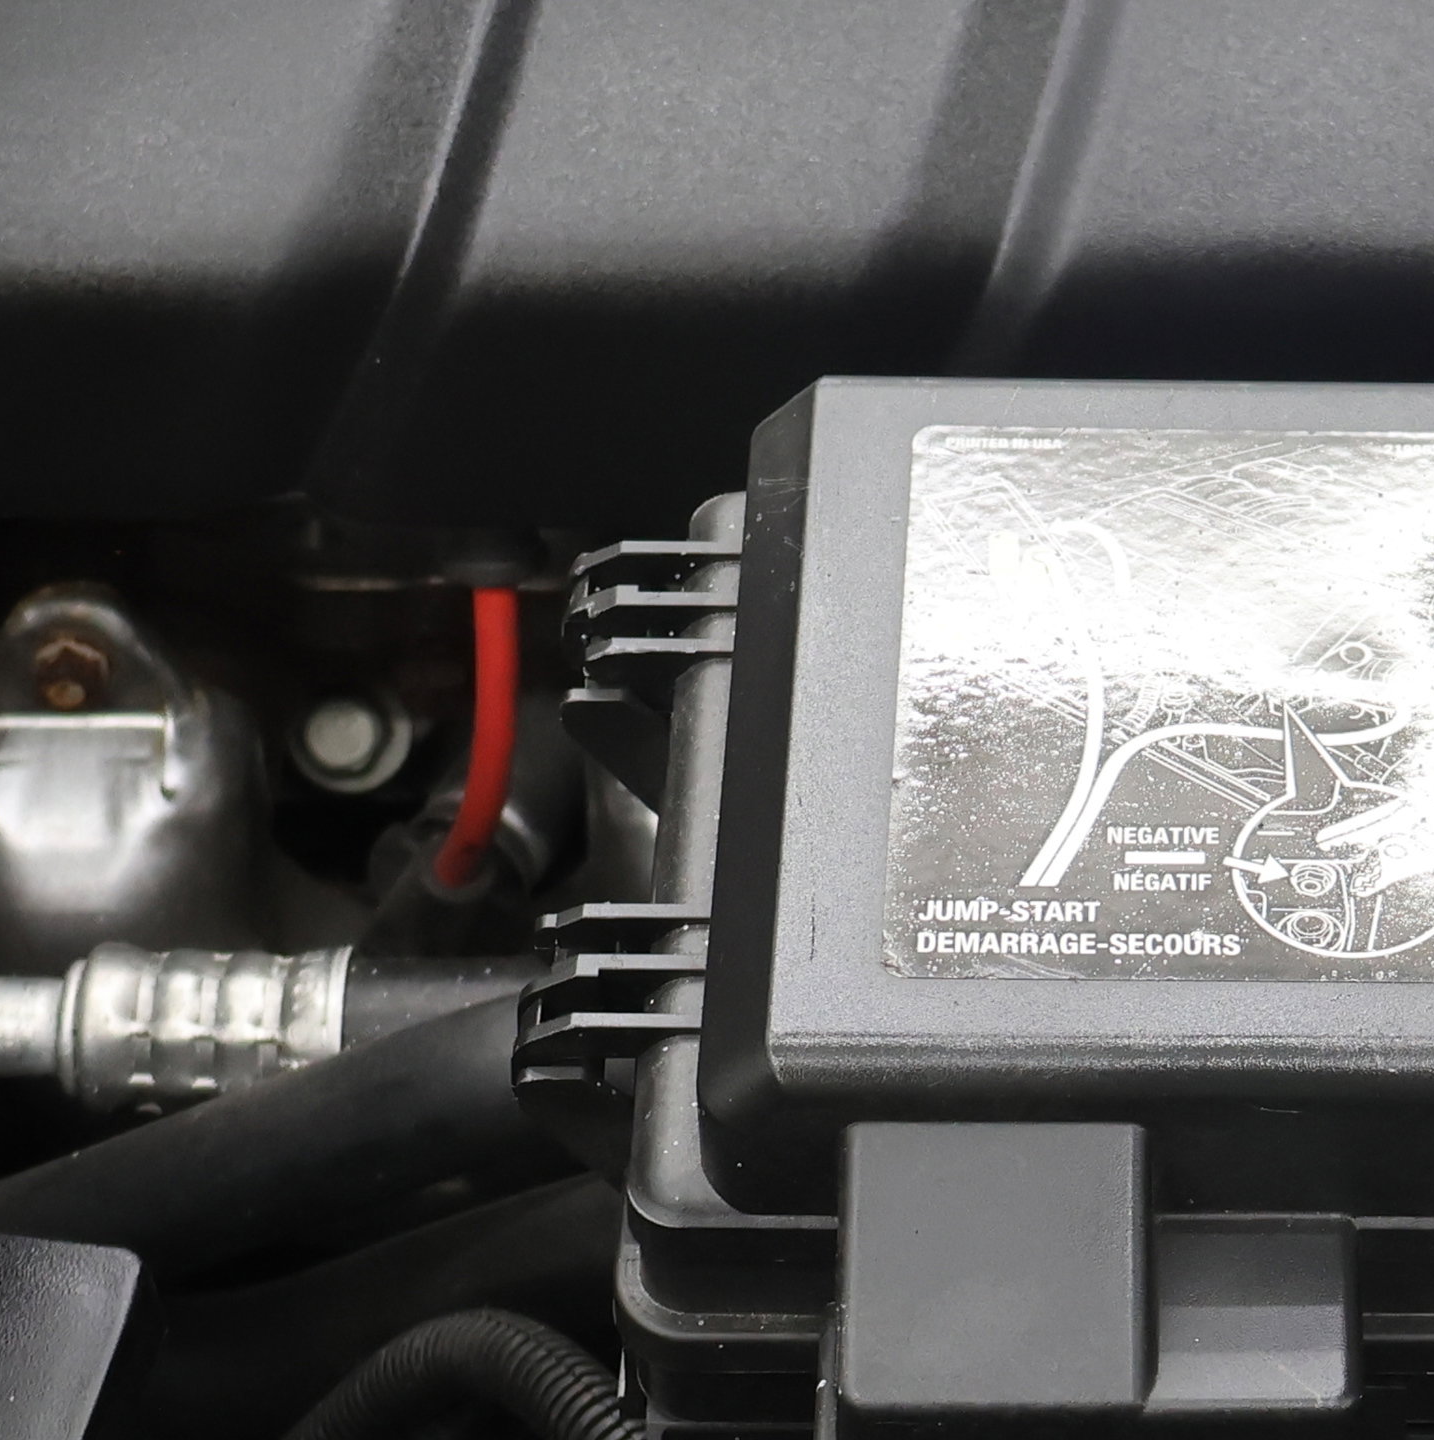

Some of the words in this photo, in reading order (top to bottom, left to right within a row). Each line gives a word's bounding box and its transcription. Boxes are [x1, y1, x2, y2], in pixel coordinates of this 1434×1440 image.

[1107, 826, 1219, 845] NEGATIVE
[1113, 868, 1212, 891] NÉGATIF
[918, 901, 1100, 922] JUMP-START
